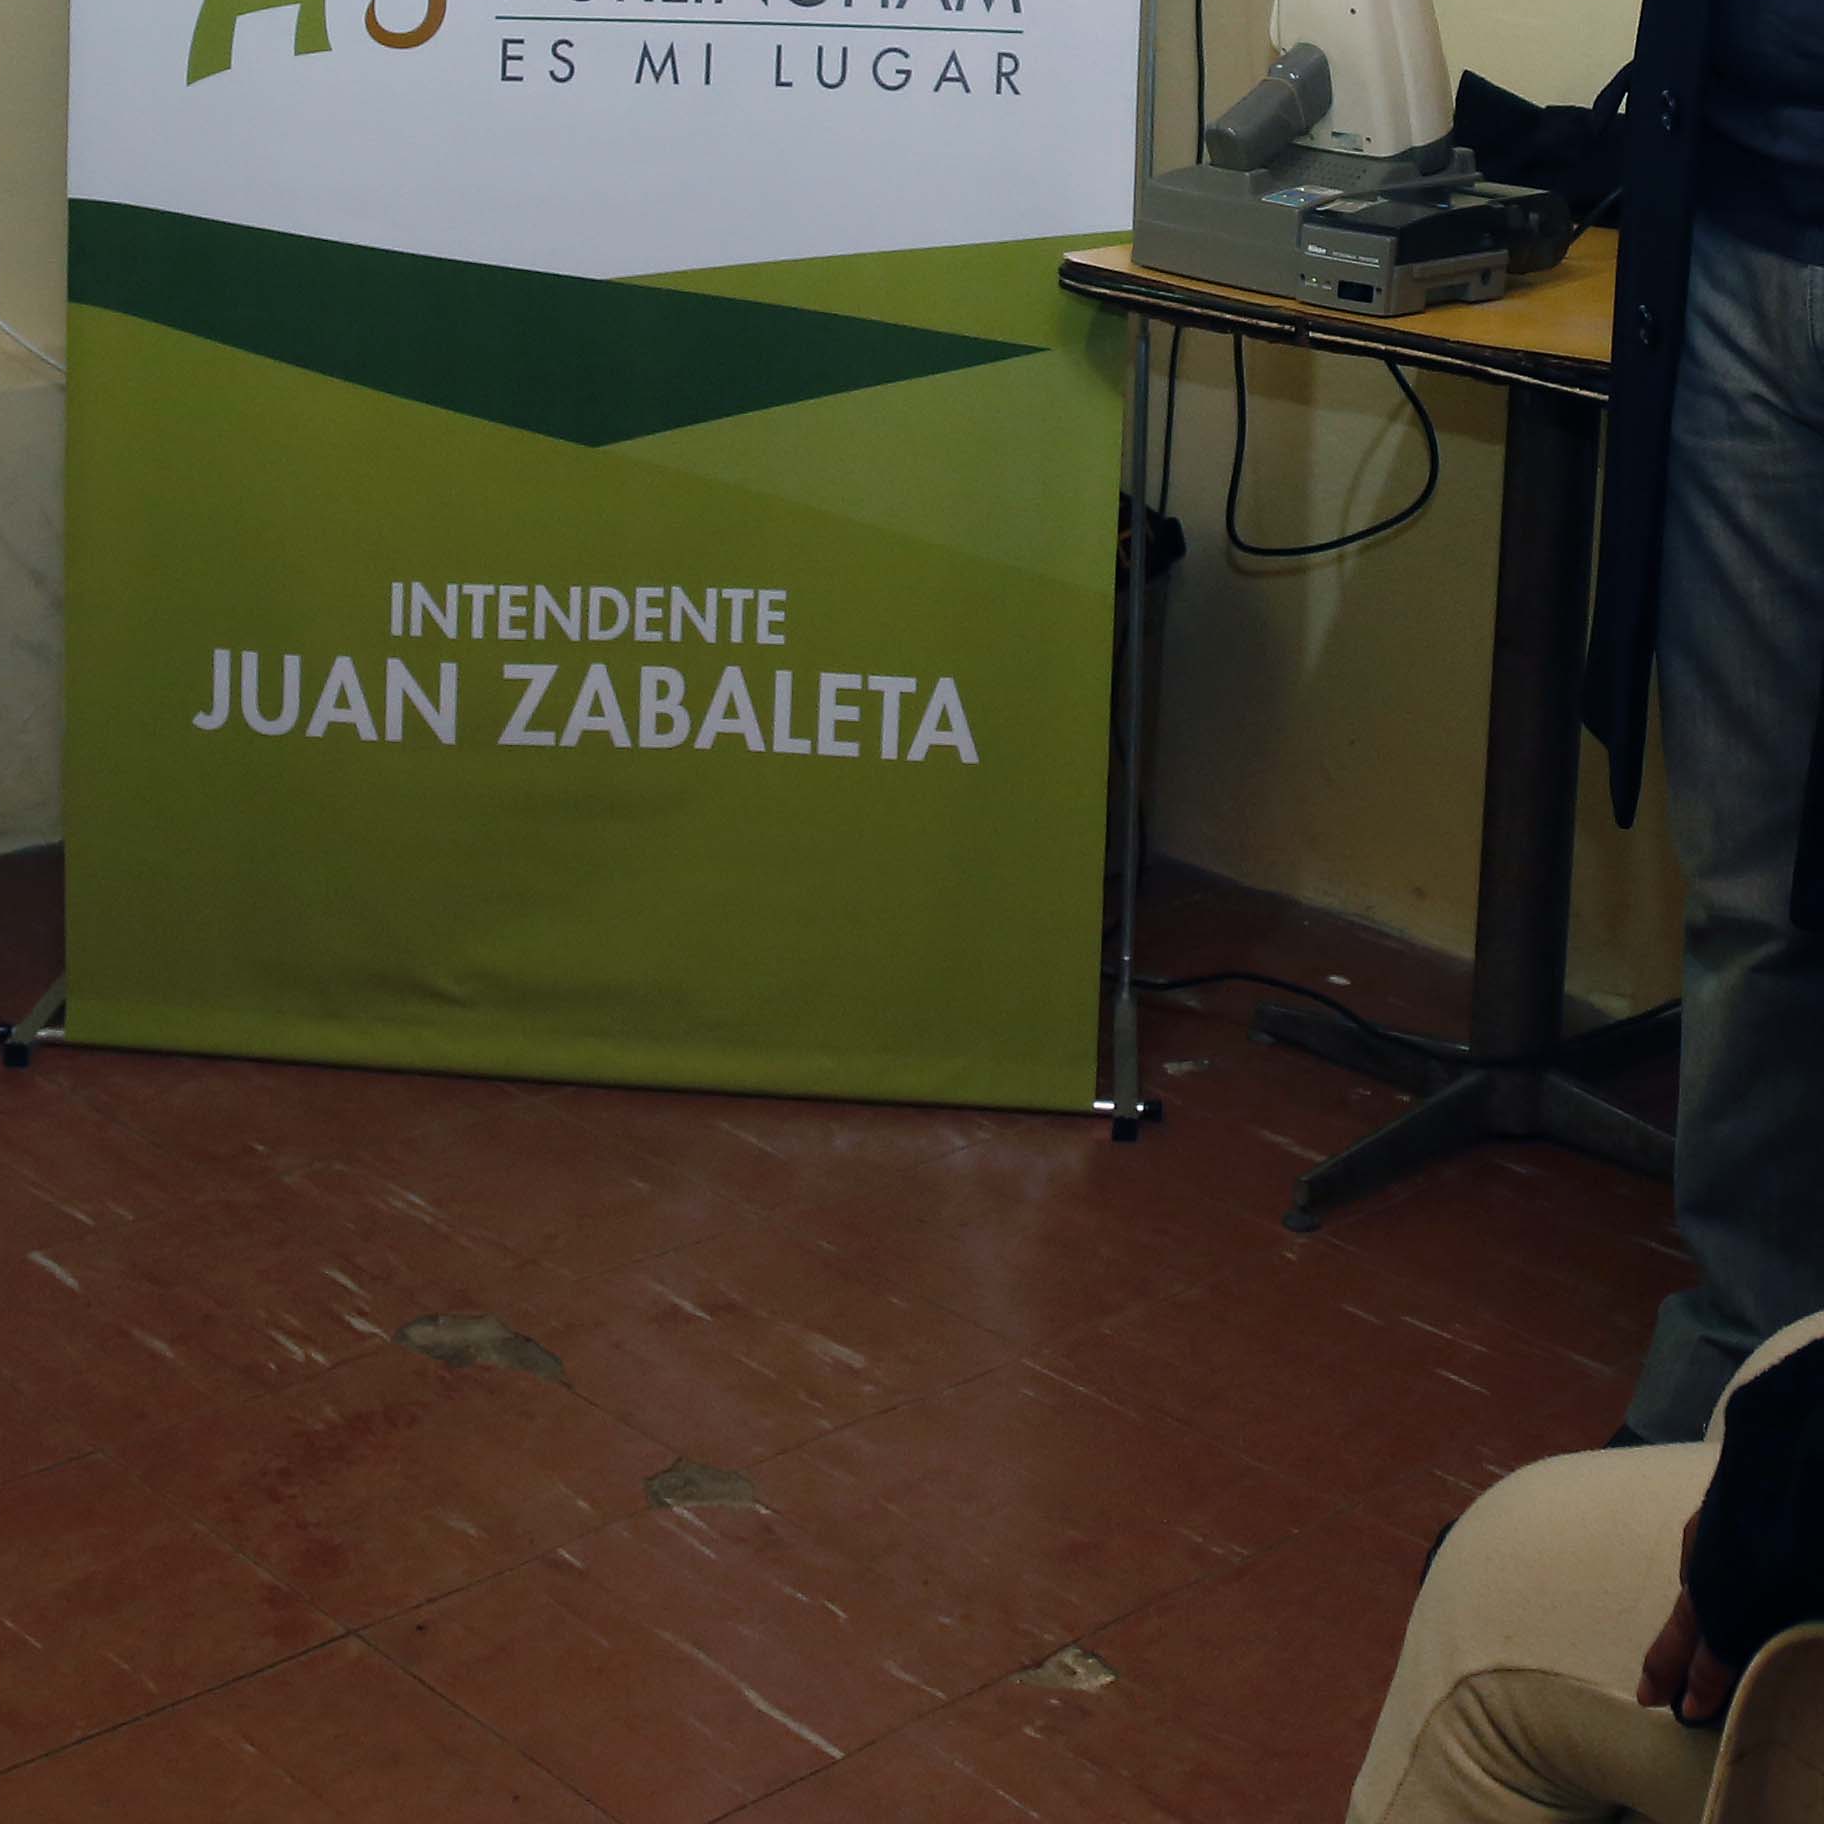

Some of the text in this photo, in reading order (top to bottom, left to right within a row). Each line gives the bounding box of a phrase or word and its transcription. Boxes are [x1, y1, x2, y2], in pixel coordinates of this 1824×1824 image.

[501, 39, 1022, 96] ES MI LUGAR
[390, 582, 787, 644] INTENDENTE
[192, 648, 979, 764] JUAN ZABALETA
